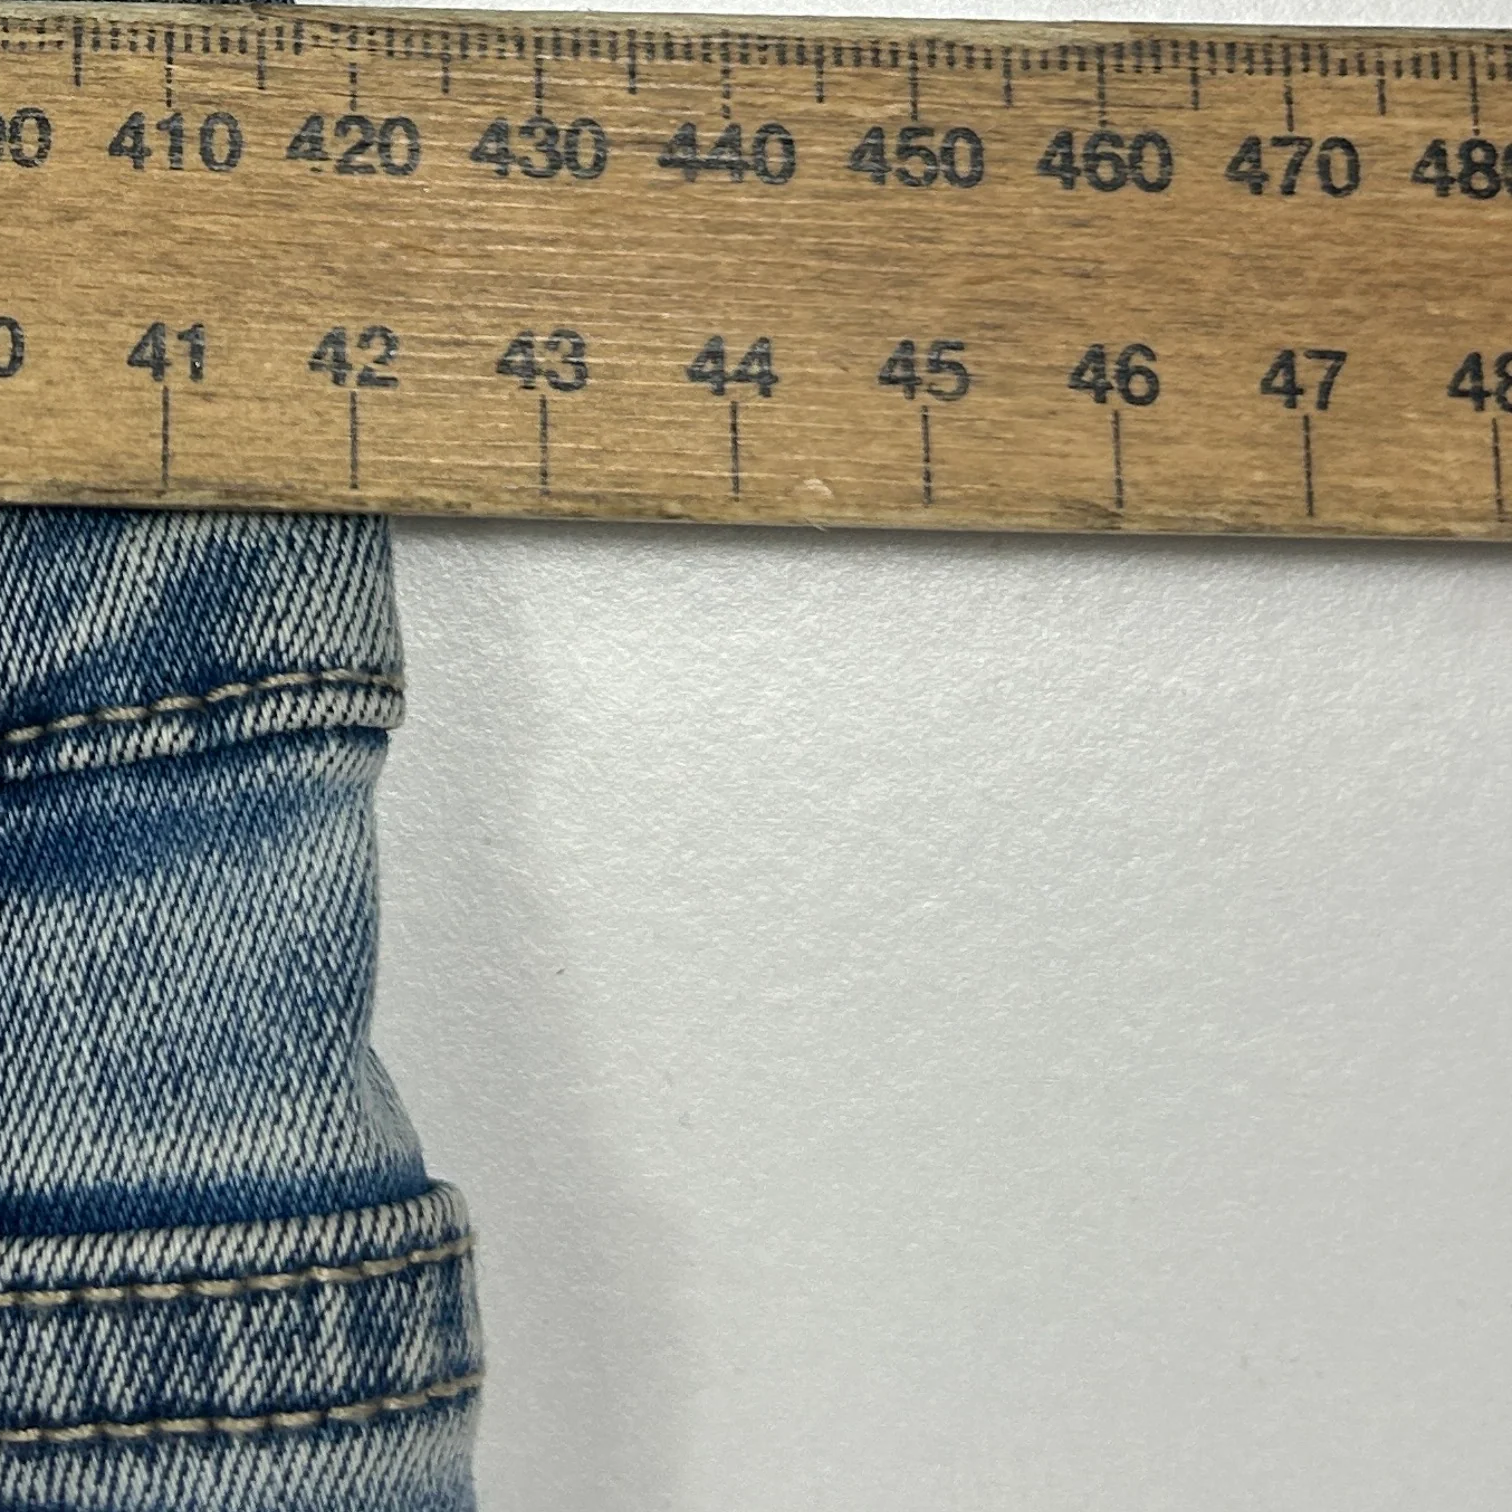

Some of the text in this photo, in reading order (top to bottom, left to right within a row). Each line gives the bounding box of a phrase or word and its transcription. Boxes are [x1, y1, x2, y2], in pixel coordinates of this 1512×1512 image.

[107, 111, 244, 172] 410
[287, 113, 421, 175] 420
[469, 116, 608, 179] 430
[657, 122, 796, 185] 440
[849, 125, 985, 188] 450
[1036, 129, 1173, 192] 460
[1224, 134, 1361, 198] 470
[1411, 138, 1512, 199] 48
[126, 322, 207, 382] 41
[308, 325, 401, 388] 42
[495, 329, 589, 392] 43
[686, 335, 780, 398] 44
[877, 339, 971, 402] 45
[1068, 343, 1161, 406] 46
[1259, 349, 1348, 411] 47
